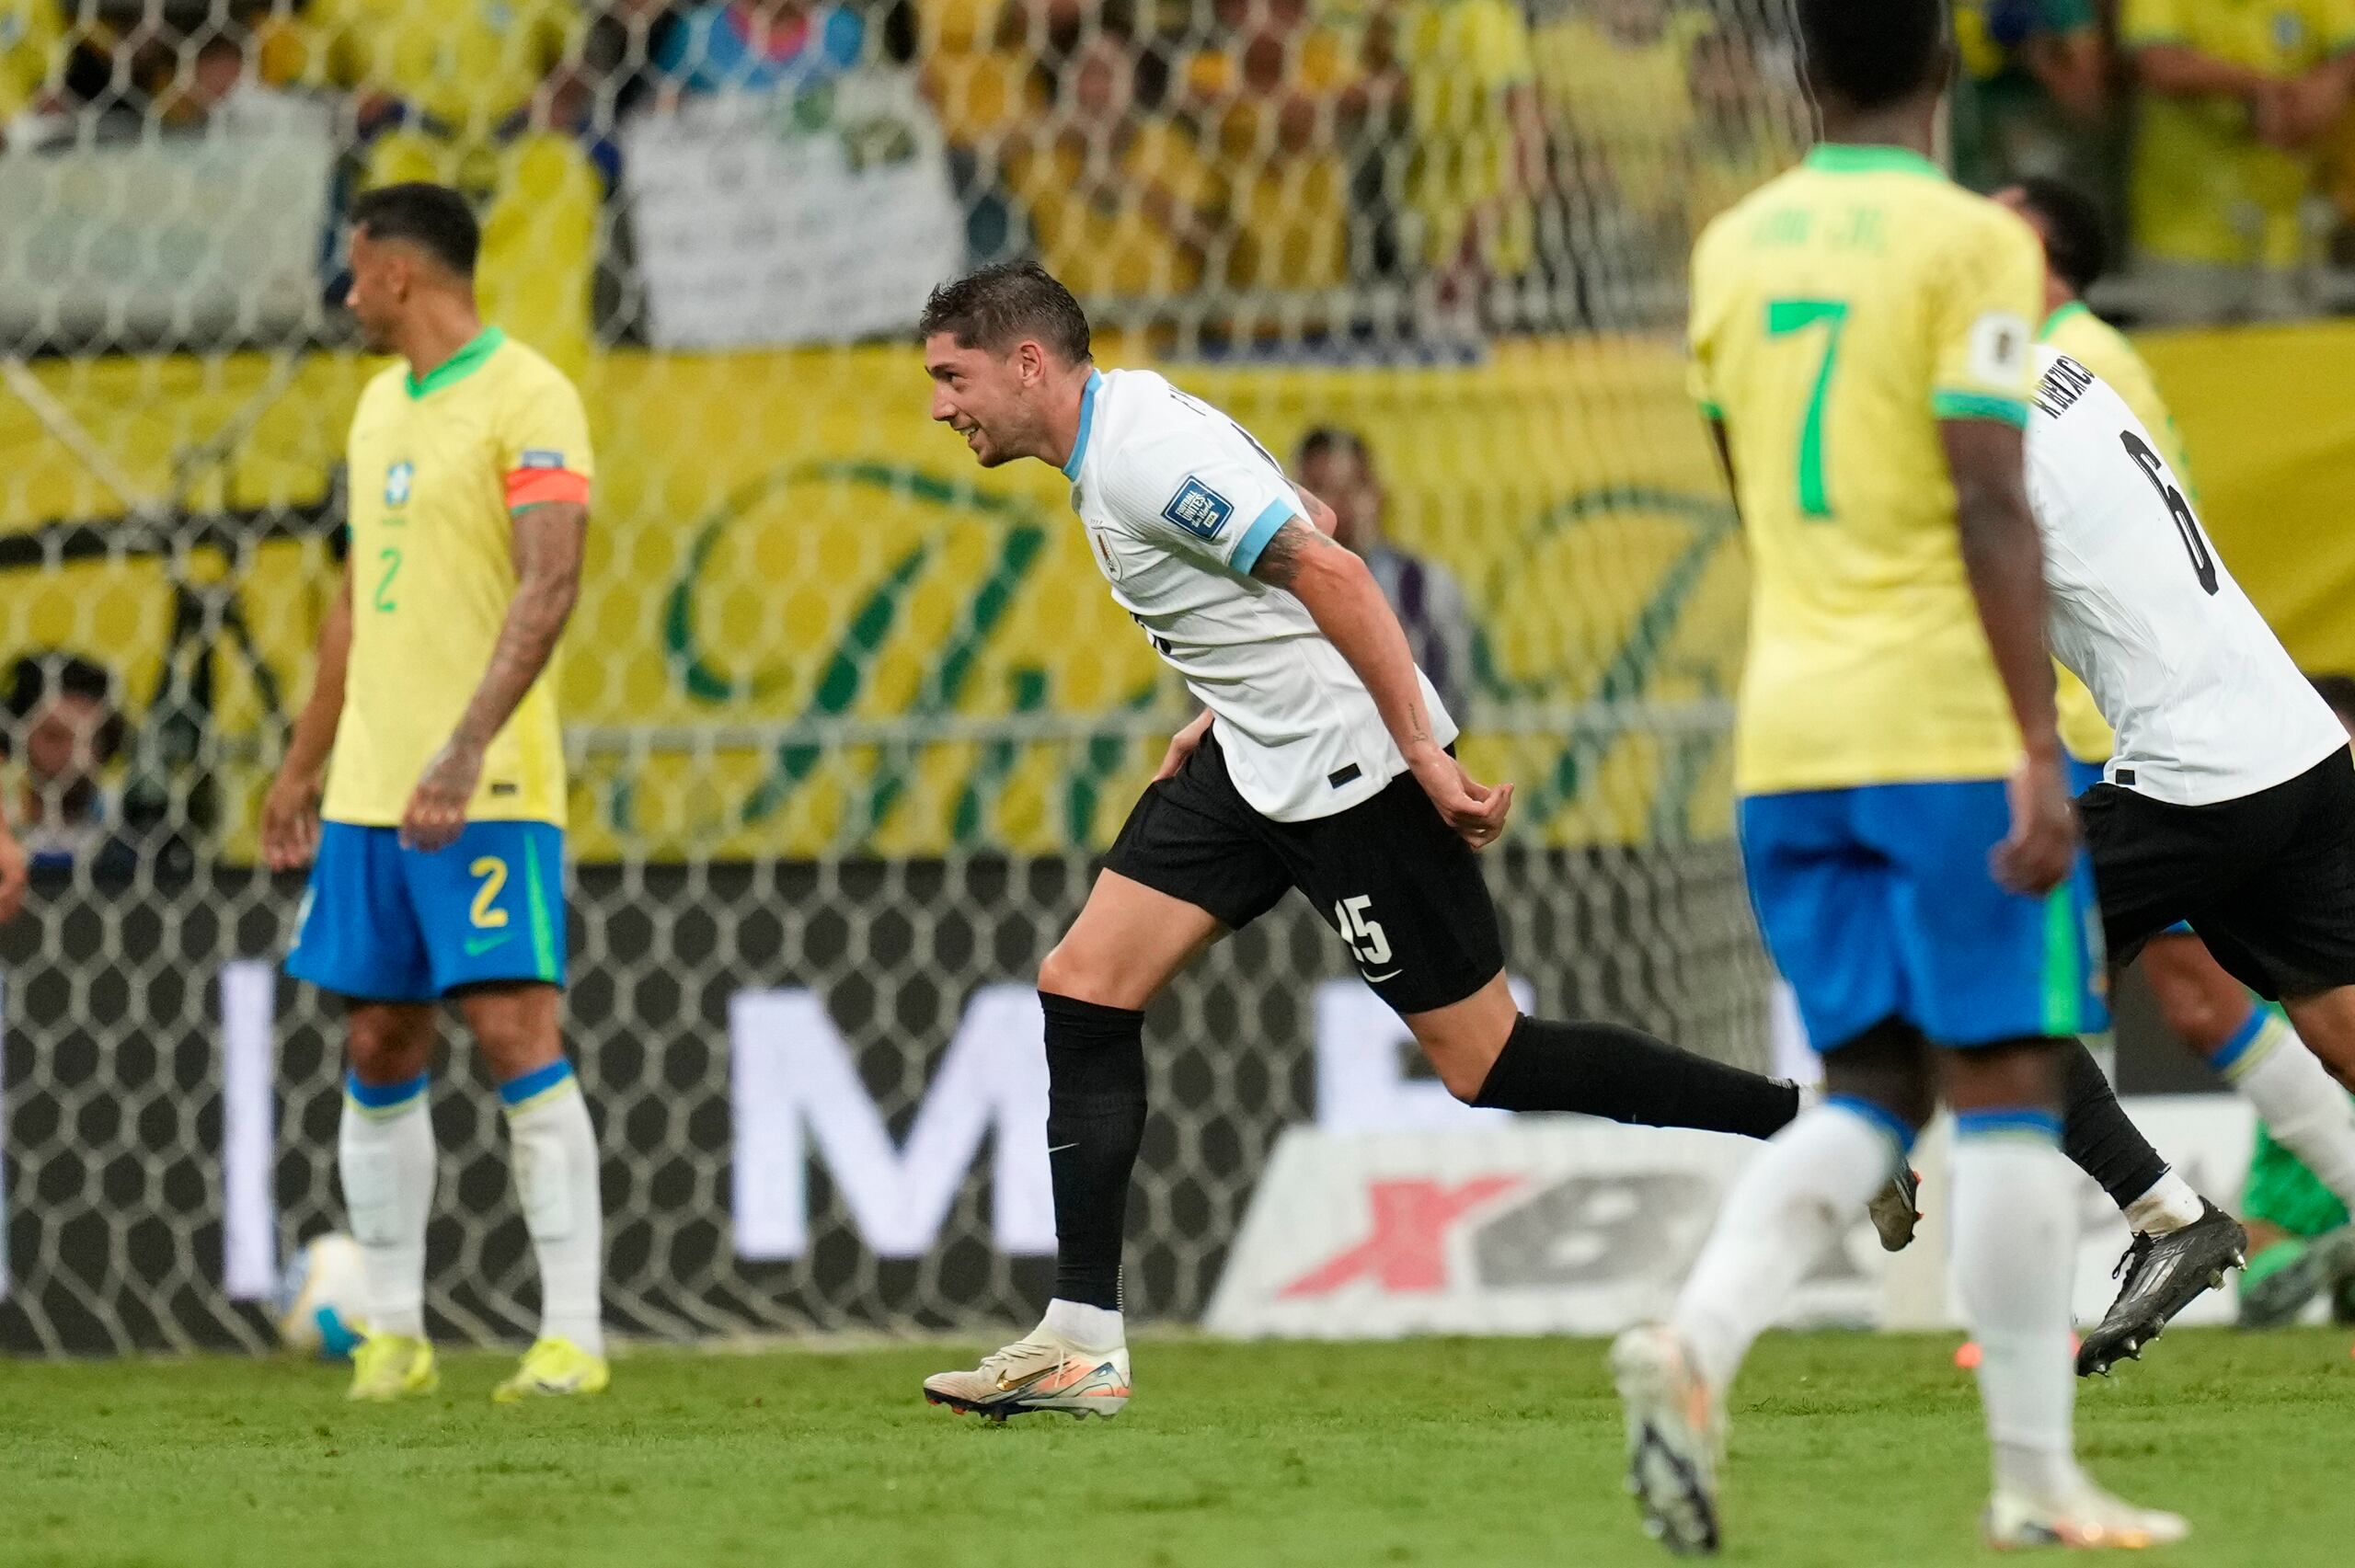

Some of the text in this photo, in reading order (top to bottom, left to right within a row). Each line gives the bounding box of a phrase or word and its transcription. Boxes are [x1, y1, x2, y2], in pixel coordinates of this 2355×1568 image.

[1768, 300, 1846, 515] 7
[1175, 490, 1197, 515] FOOTBALL
[1181, 494, 1205, 521] UNITES
[2120, 429, 2219, 596] 6
[373, 548, 402, 612] 2
[470, 855, 508, 928] 2
[1335, 894, 1392, 965] 15
